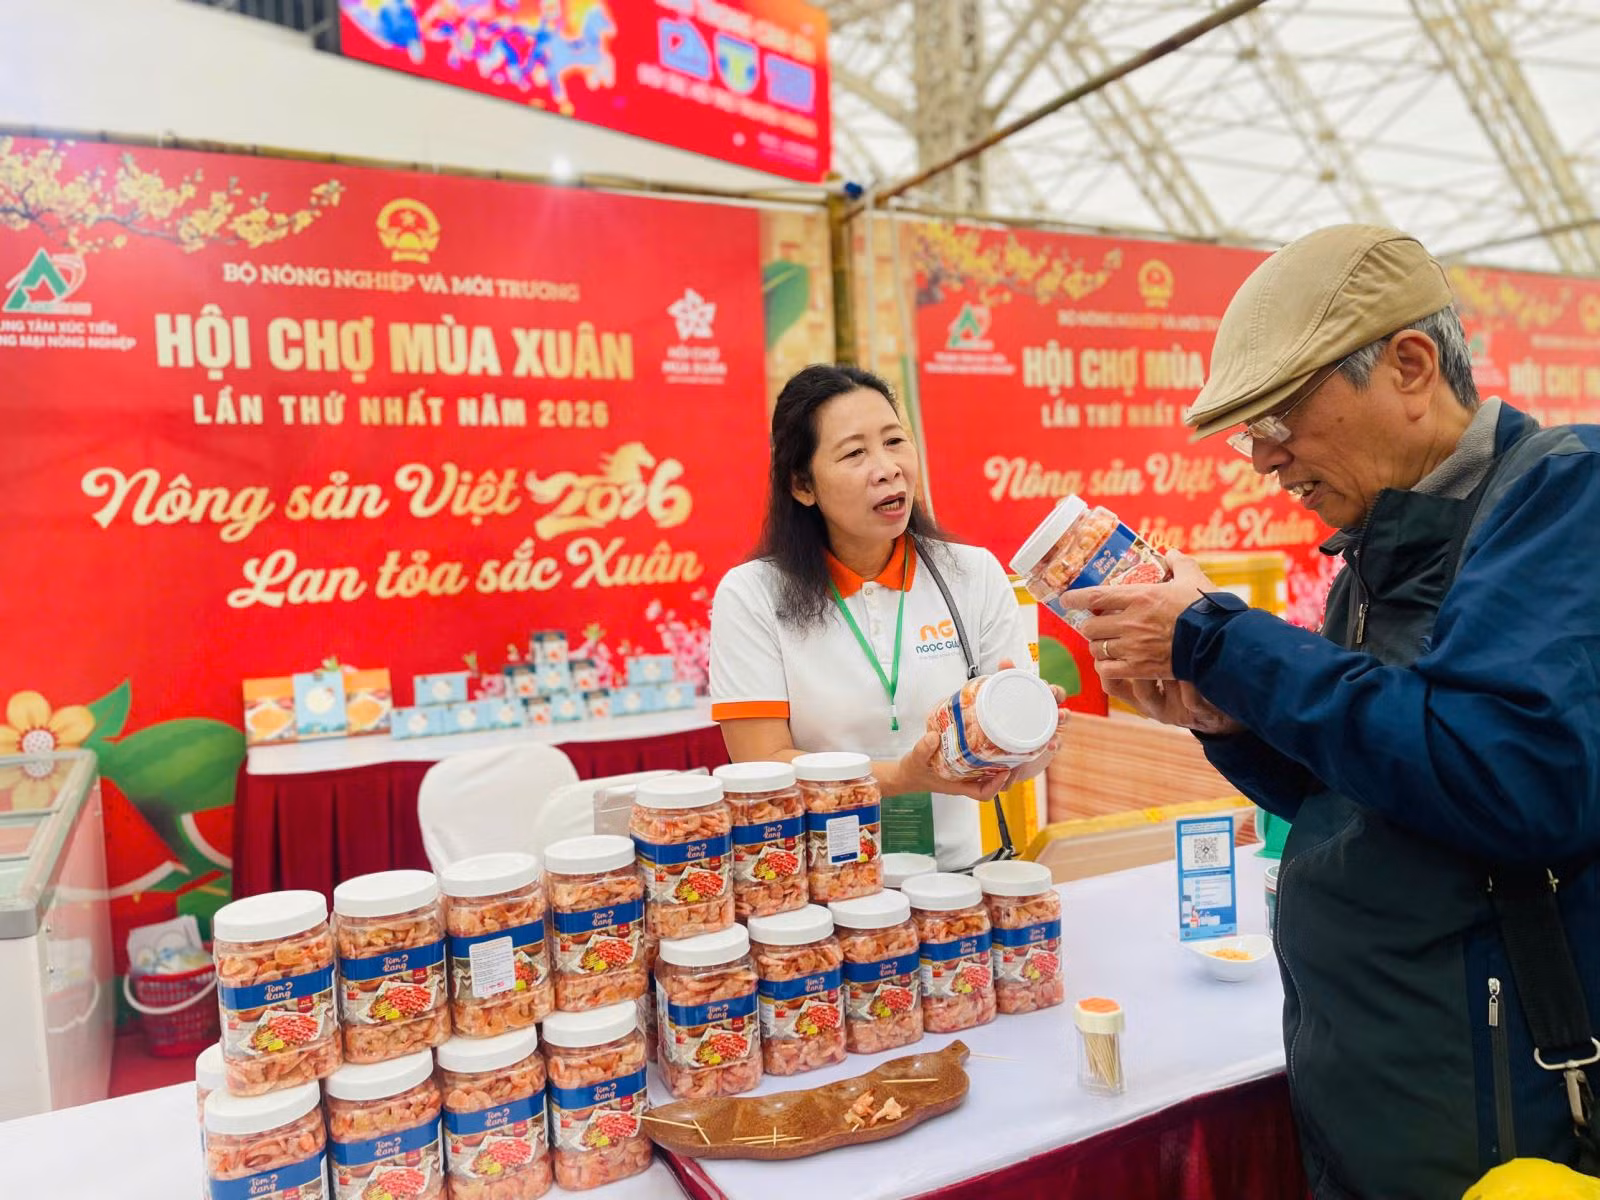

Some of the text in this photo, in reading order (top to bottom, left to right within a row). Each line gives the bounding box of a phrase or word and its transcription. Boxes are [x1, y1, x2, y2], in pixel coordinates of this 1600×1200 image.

[223, 262, 257, 285] BỘ
[260, 263, 331, 288] NÔNG
[333, 269, 415, 294] NGHIỆP
[155, 303, 634, 383] HỘI CHỢ MÙA XUÂN
[1022, 339, 1075, 397] HỘI
[1080, 347, 1139, 397] CHỢ
[278, 390, 347, 426] THỨ
[359, 388, 444, 426] NHẤT
[457, 393, 527, 427] NĂM
[538, 400, 609, 428] 2026
[81, 466, 275, 543] Nông
[284, 470, 390, 521] sản
[395, 461, 522, 526] Việt
[983, 455, 1085, 510] Nông
[1088, 458, 1145, 496] sản
[227, 536, 704, 608] Lan tỏa sắc Xuân
